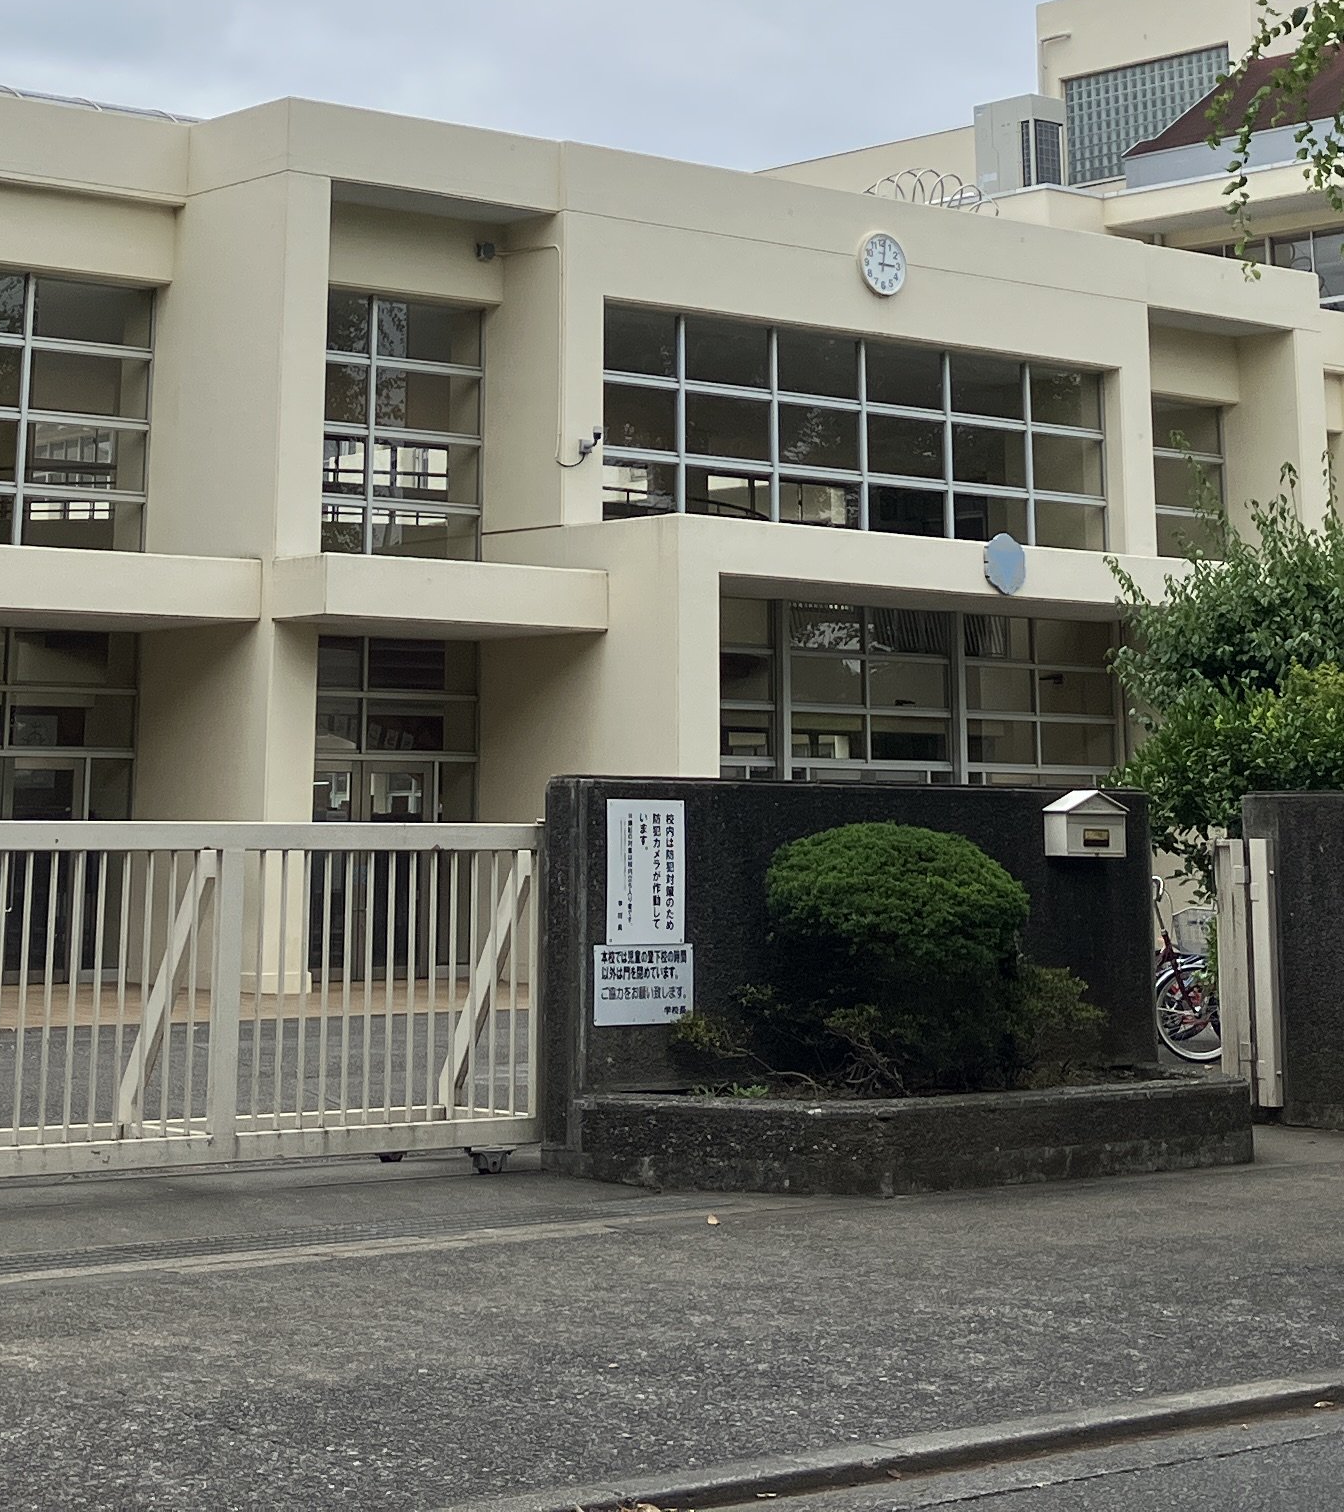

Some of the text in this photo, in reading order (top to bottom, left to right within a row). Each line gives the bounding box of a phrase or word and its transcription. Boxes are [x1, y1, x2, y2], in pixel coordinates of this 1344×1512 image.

[639, 812, 649, 851] います。
[652, 813, 661, 930] 防犯カメラが作動して
[666, 813, 675, 931] 校内は防犯対策のため
[601, 949, 687, 964] 本校では児童の登下校の時間
[602, 966, 678, 980] 以外は門を閉めています。
[601, 986, 687, 1000] ご協力をお願い致します。
[664, 1005, 687, 1015] 学校長
